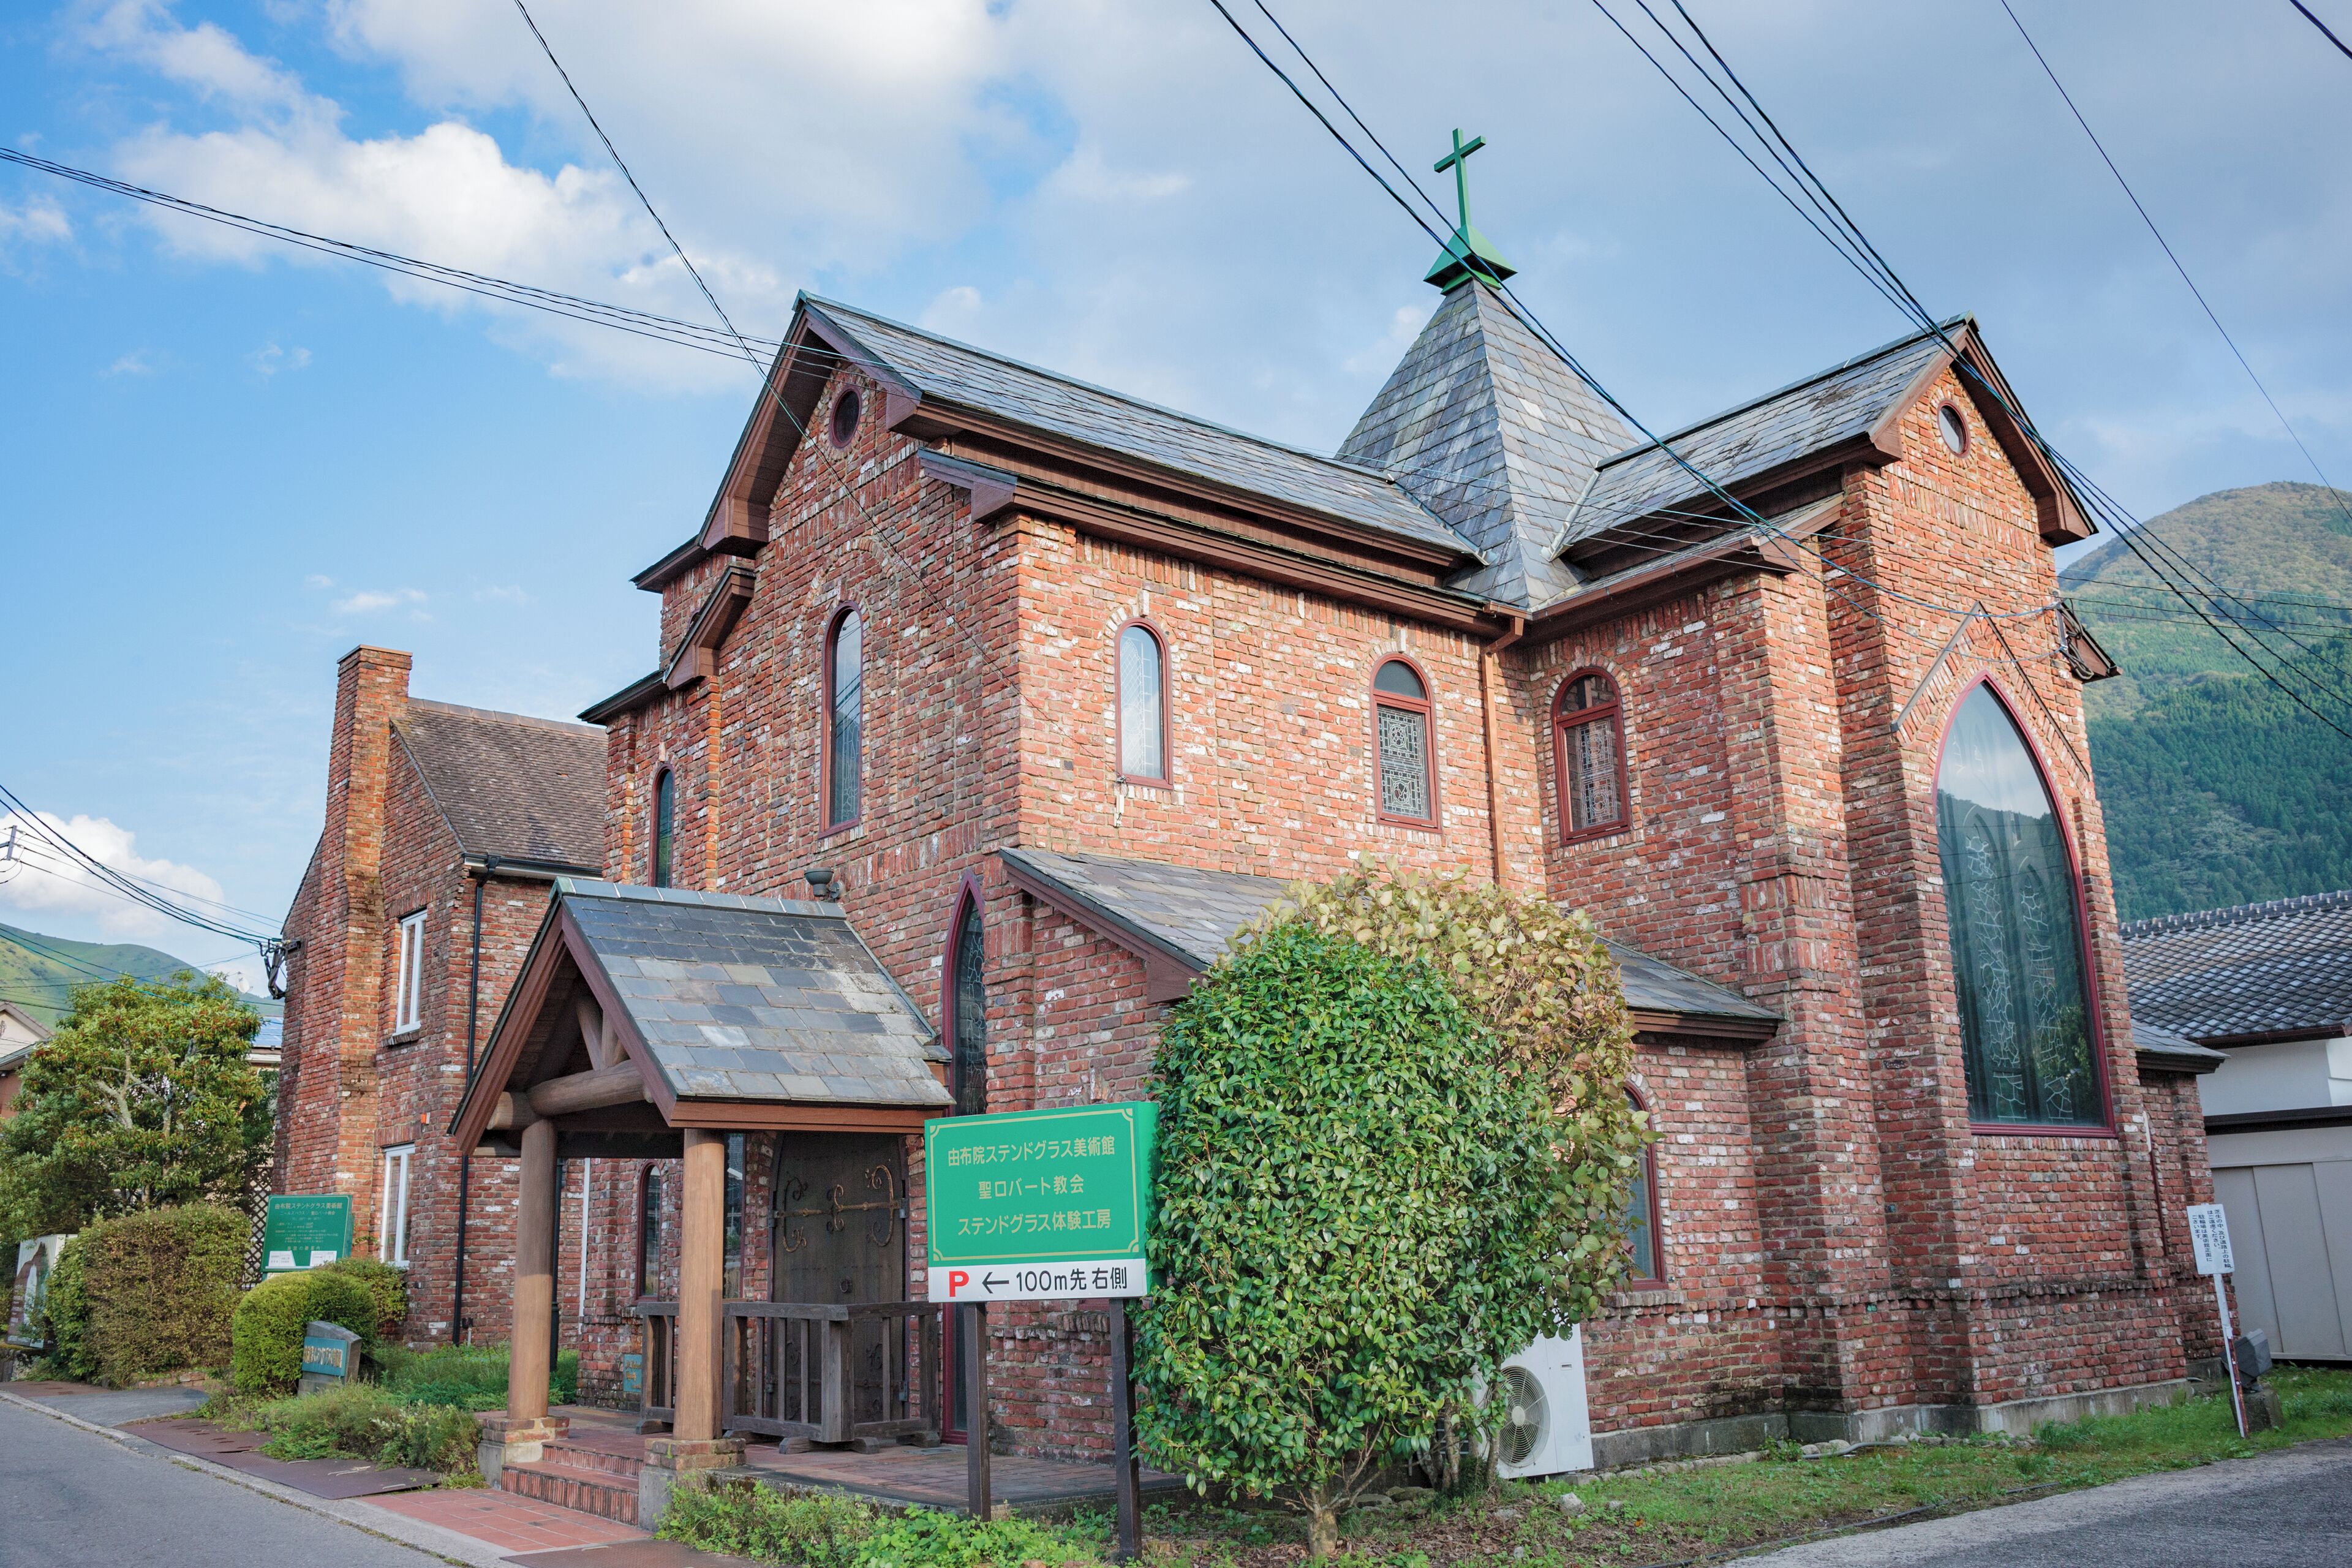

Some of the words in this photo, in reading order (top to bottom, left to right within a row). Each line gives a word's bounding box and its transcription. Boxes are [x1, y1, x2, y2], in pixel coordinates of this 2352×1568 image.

[948, 1136, 1115, 1166] 由布院ステンドグラス美術館
[978, 1174, 1084, 1199] 聖ロバート教会
[957, 1208, 1112, 1235] ステンドグラス体験工房
[949, 1271, 970, 1297] P
